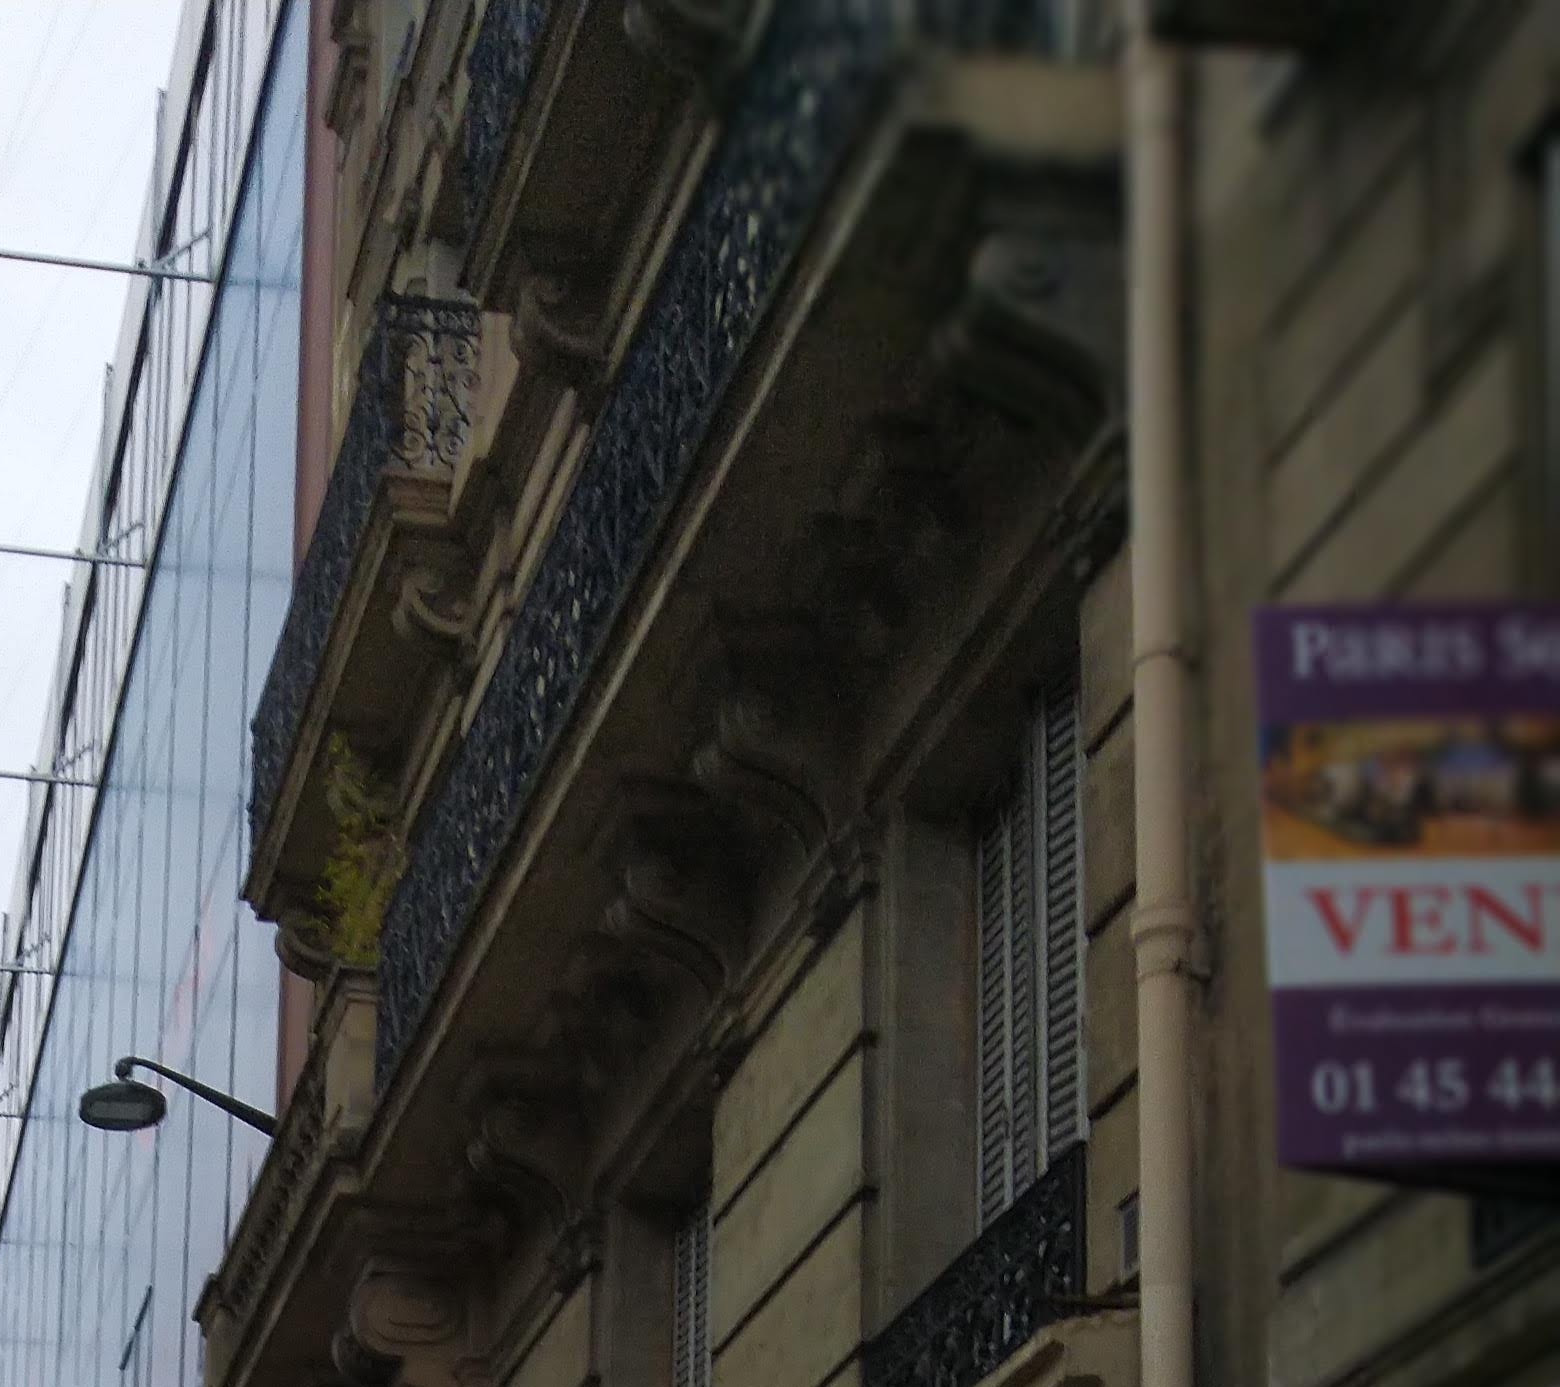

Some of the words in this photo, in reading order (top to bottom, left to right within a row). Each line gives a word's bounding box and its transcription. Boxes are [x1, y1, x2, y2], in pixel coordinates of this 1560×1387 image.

[1305, 883, 1560, 959] VEN
[1311, 1059, 1378, 1116] 01
[1395, 1057, 1471, 1115] 45
[1486, 1055, 1558, 1113] 44
